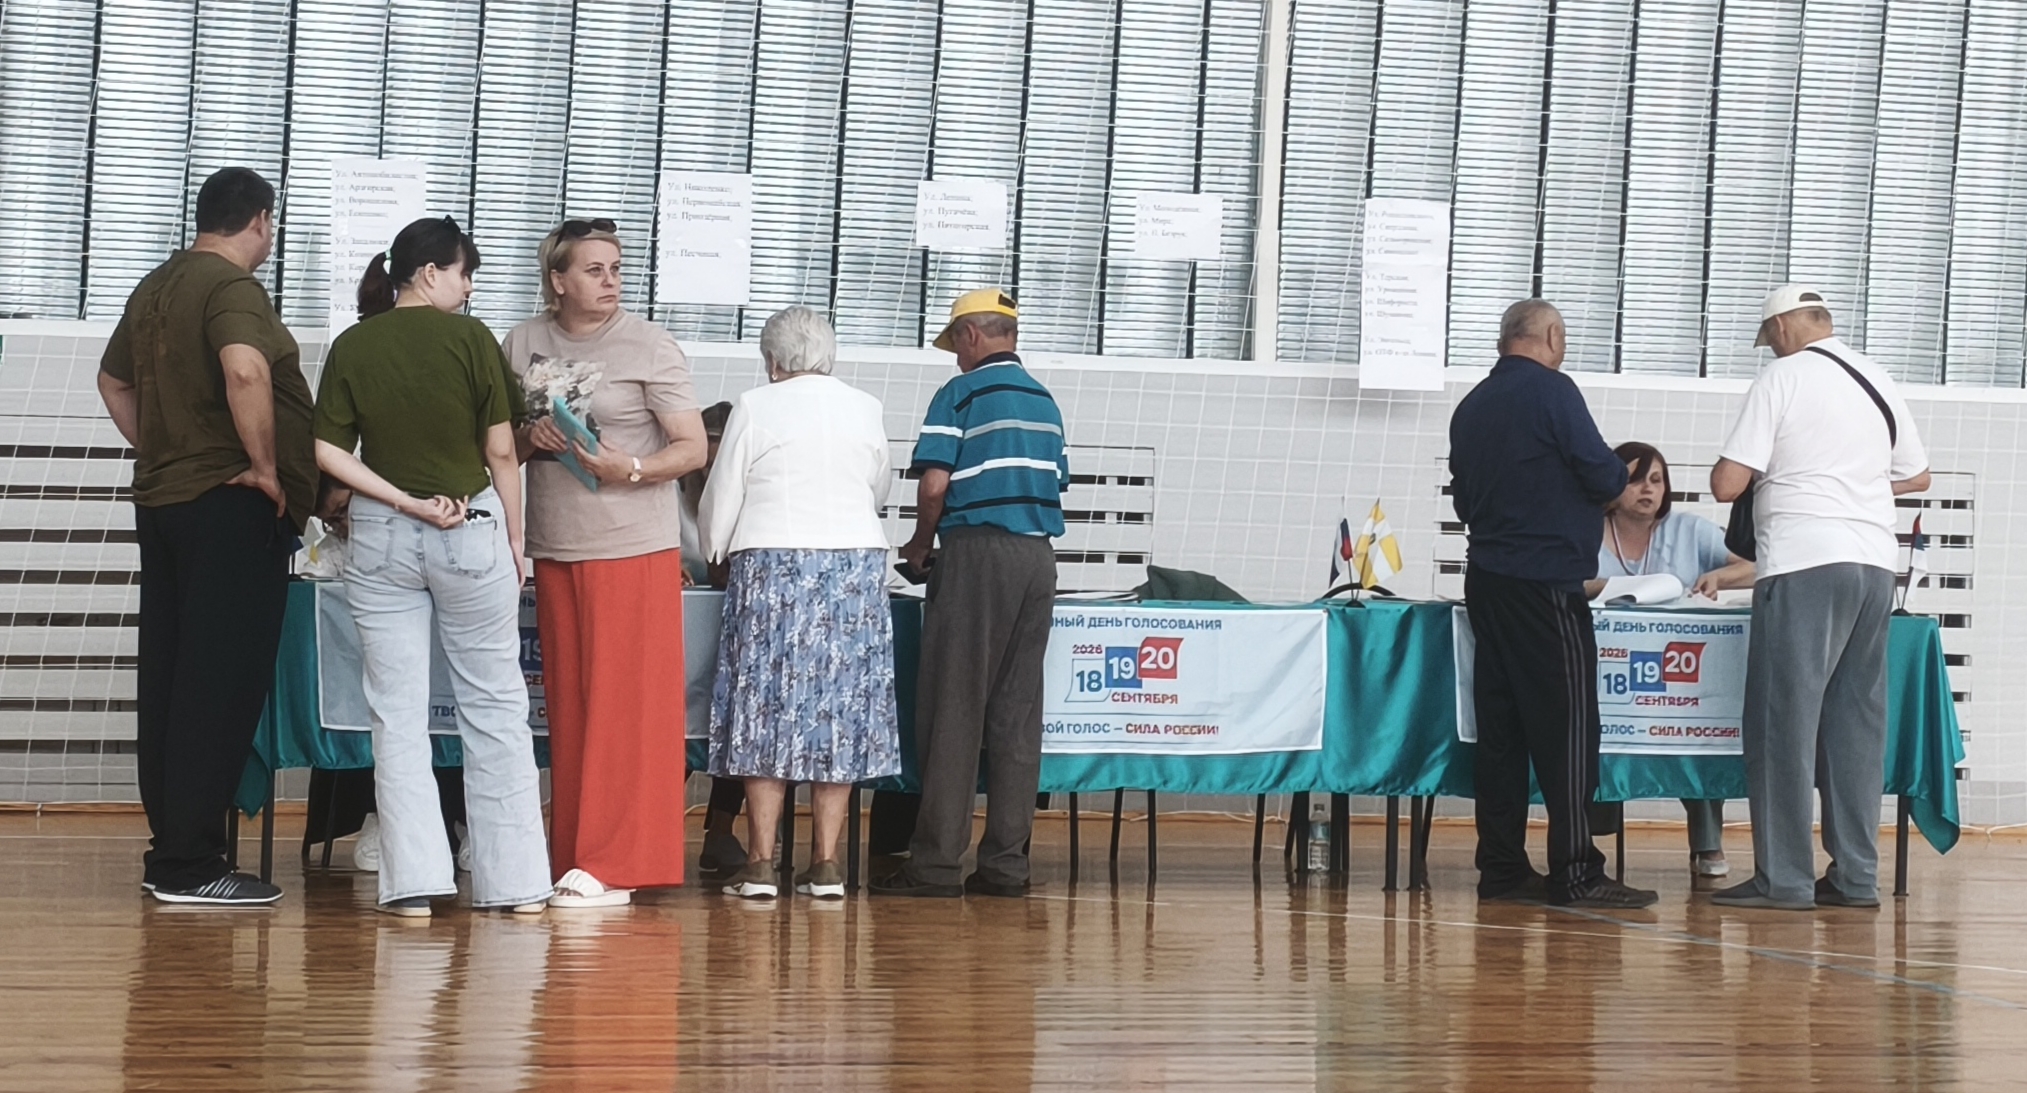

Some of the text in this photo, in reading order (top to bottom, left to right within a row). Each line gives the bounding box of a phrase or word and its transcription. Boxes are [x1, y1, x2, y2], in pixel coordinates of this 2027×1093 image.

[1052, 614, 1222, 631] НЫЙ ДЕНЬ ГОЛОСОВАНИЯ
[1613, 620, 1647, 633] ДЕНЬ
[1649, 622, 1744, 636] ГОЛОСОВАНИЯ
[1140, 646, 1175, 670] 20
[1665, 650, 1697, 674] 20
[1109, 657, 1135, 680] 19
[1633, 661, 1660, 683] 19
[1076, 670, 1103, 693] 18
[1603, 674, 1627, 695] 18
[1111, 692, 1178, 704] СЕНТЯБРЯ
[1635, 695, 1700, 707] СЕНТЯБРЯ
[1067, 723, 1111, 735] ГОЛОС
[1126, 723, 1161, 736] СИЛА
[1601, 724, 1635, 735] ОЛОС
[1649, 726, 1683, 737] СИЛА
